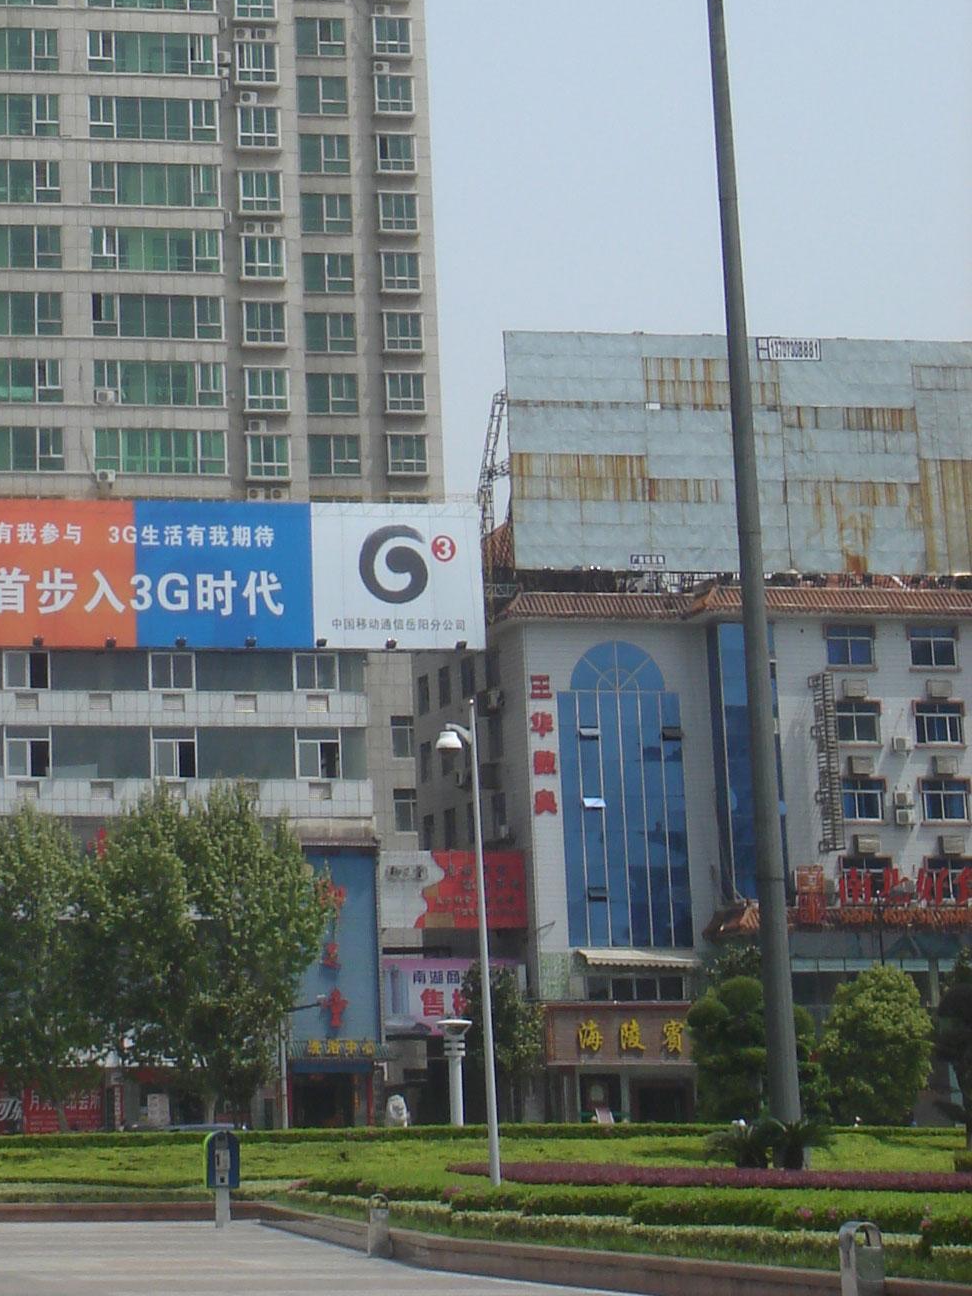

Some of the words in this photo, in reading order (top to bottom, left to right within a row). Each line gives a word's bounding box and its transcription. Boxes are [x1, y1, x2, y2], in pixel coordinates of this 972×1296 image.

[107, 524, 275, 547] 3G生活有我期待
[331, 618, 466, 631] 中国移动通信岳阳分公司
